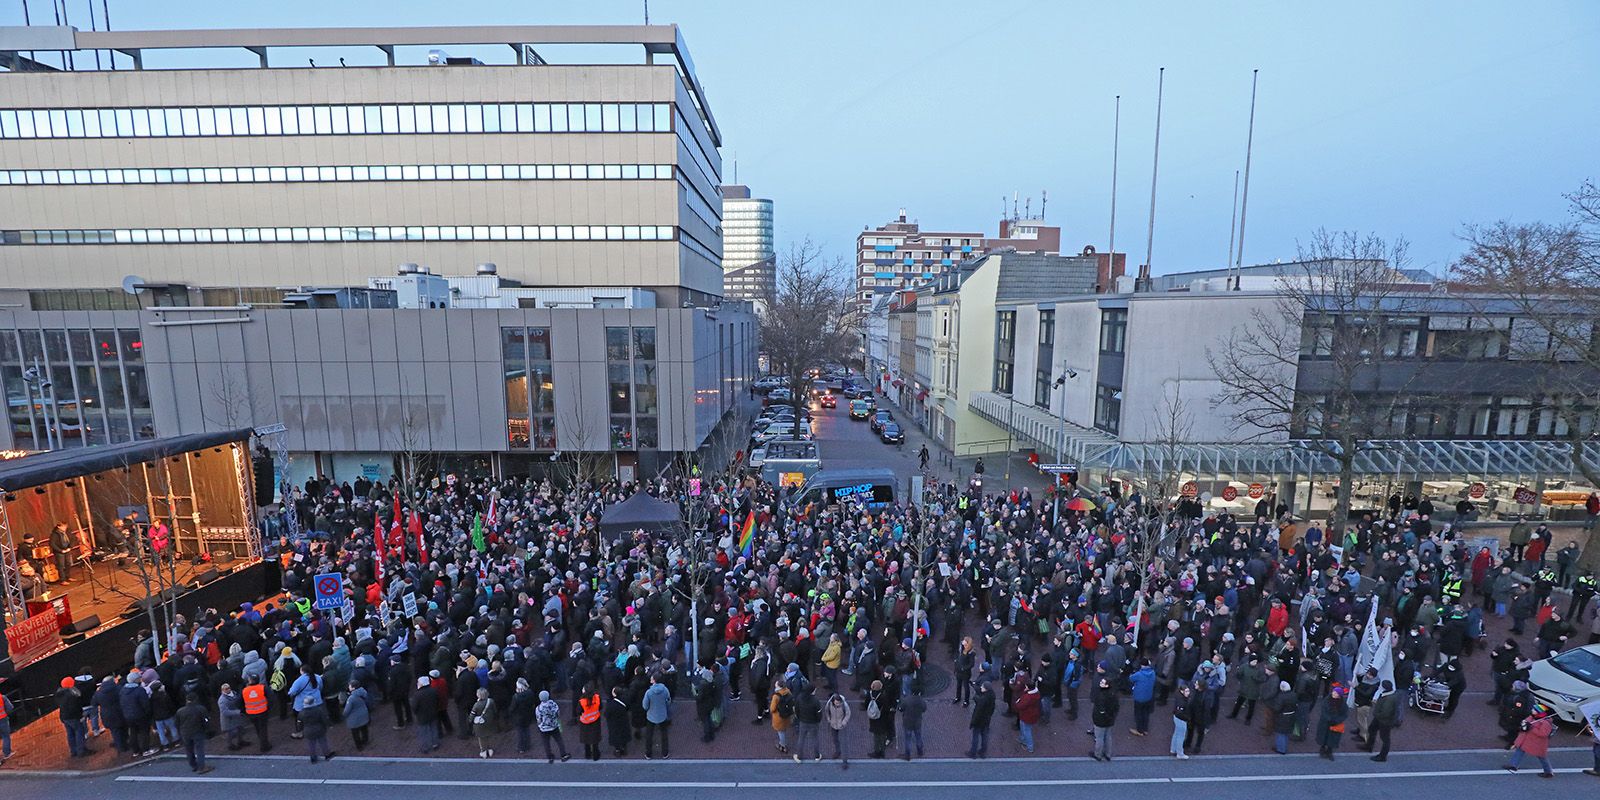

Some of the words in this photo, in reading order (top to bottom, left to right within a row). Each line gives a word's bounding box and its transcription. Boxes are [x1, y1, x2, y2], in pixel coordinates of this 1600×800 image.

[835, 487, 853, 497] HIP
[853, 483, 873, 493] HOP
[320, 597, 342, 606] TAXI
[16, 634, 31, 648] IST
[34, 621, 58, 640] HEUTE
